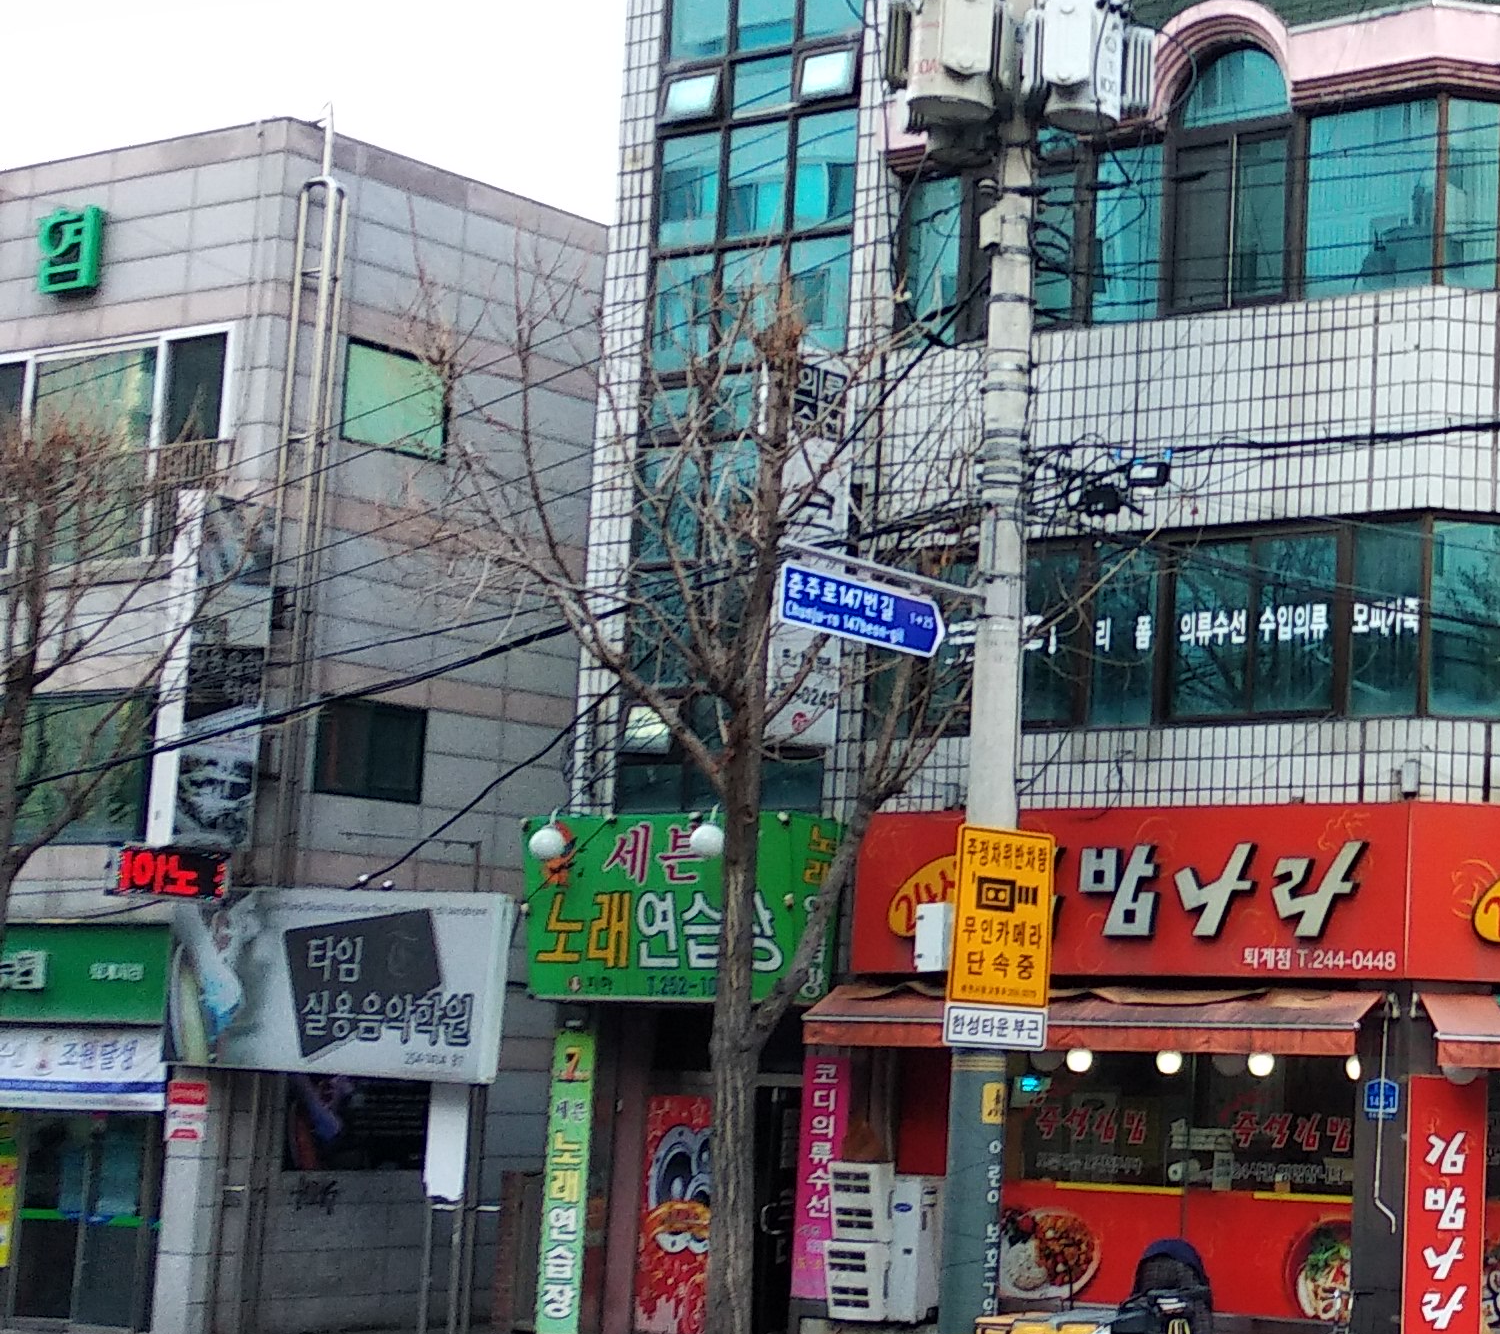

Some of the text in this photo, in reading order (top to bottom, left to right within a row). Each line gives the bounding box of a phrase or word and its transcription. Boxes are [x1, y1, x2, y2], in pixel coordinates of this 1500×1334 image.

[37, 204, 103, 295] 협
[787, 572, 895, 623] 춘주로147번길
[1179, 608, 1248, 648] 의류수선
[1258, 603, 1328, 643] 수입의류
[1052, 839, 1370, 939] 밥나라
[307, 934, 365, 983] 타임
[962, 916, 1043, 950] 무인카메라
[1243, 946, 1397, 972] 퇴계점 T.244-0448
[301, 988, 475, 1047] 실용음악학원
[952, 1013, 1040, 1041] 한성타운 부근
[806, 1063, 840, 1219] 코디의류수선
[542, 1128, 582, 1320] 노래연습장
[1421, 1131, 1467, 1330] 김밥나라
